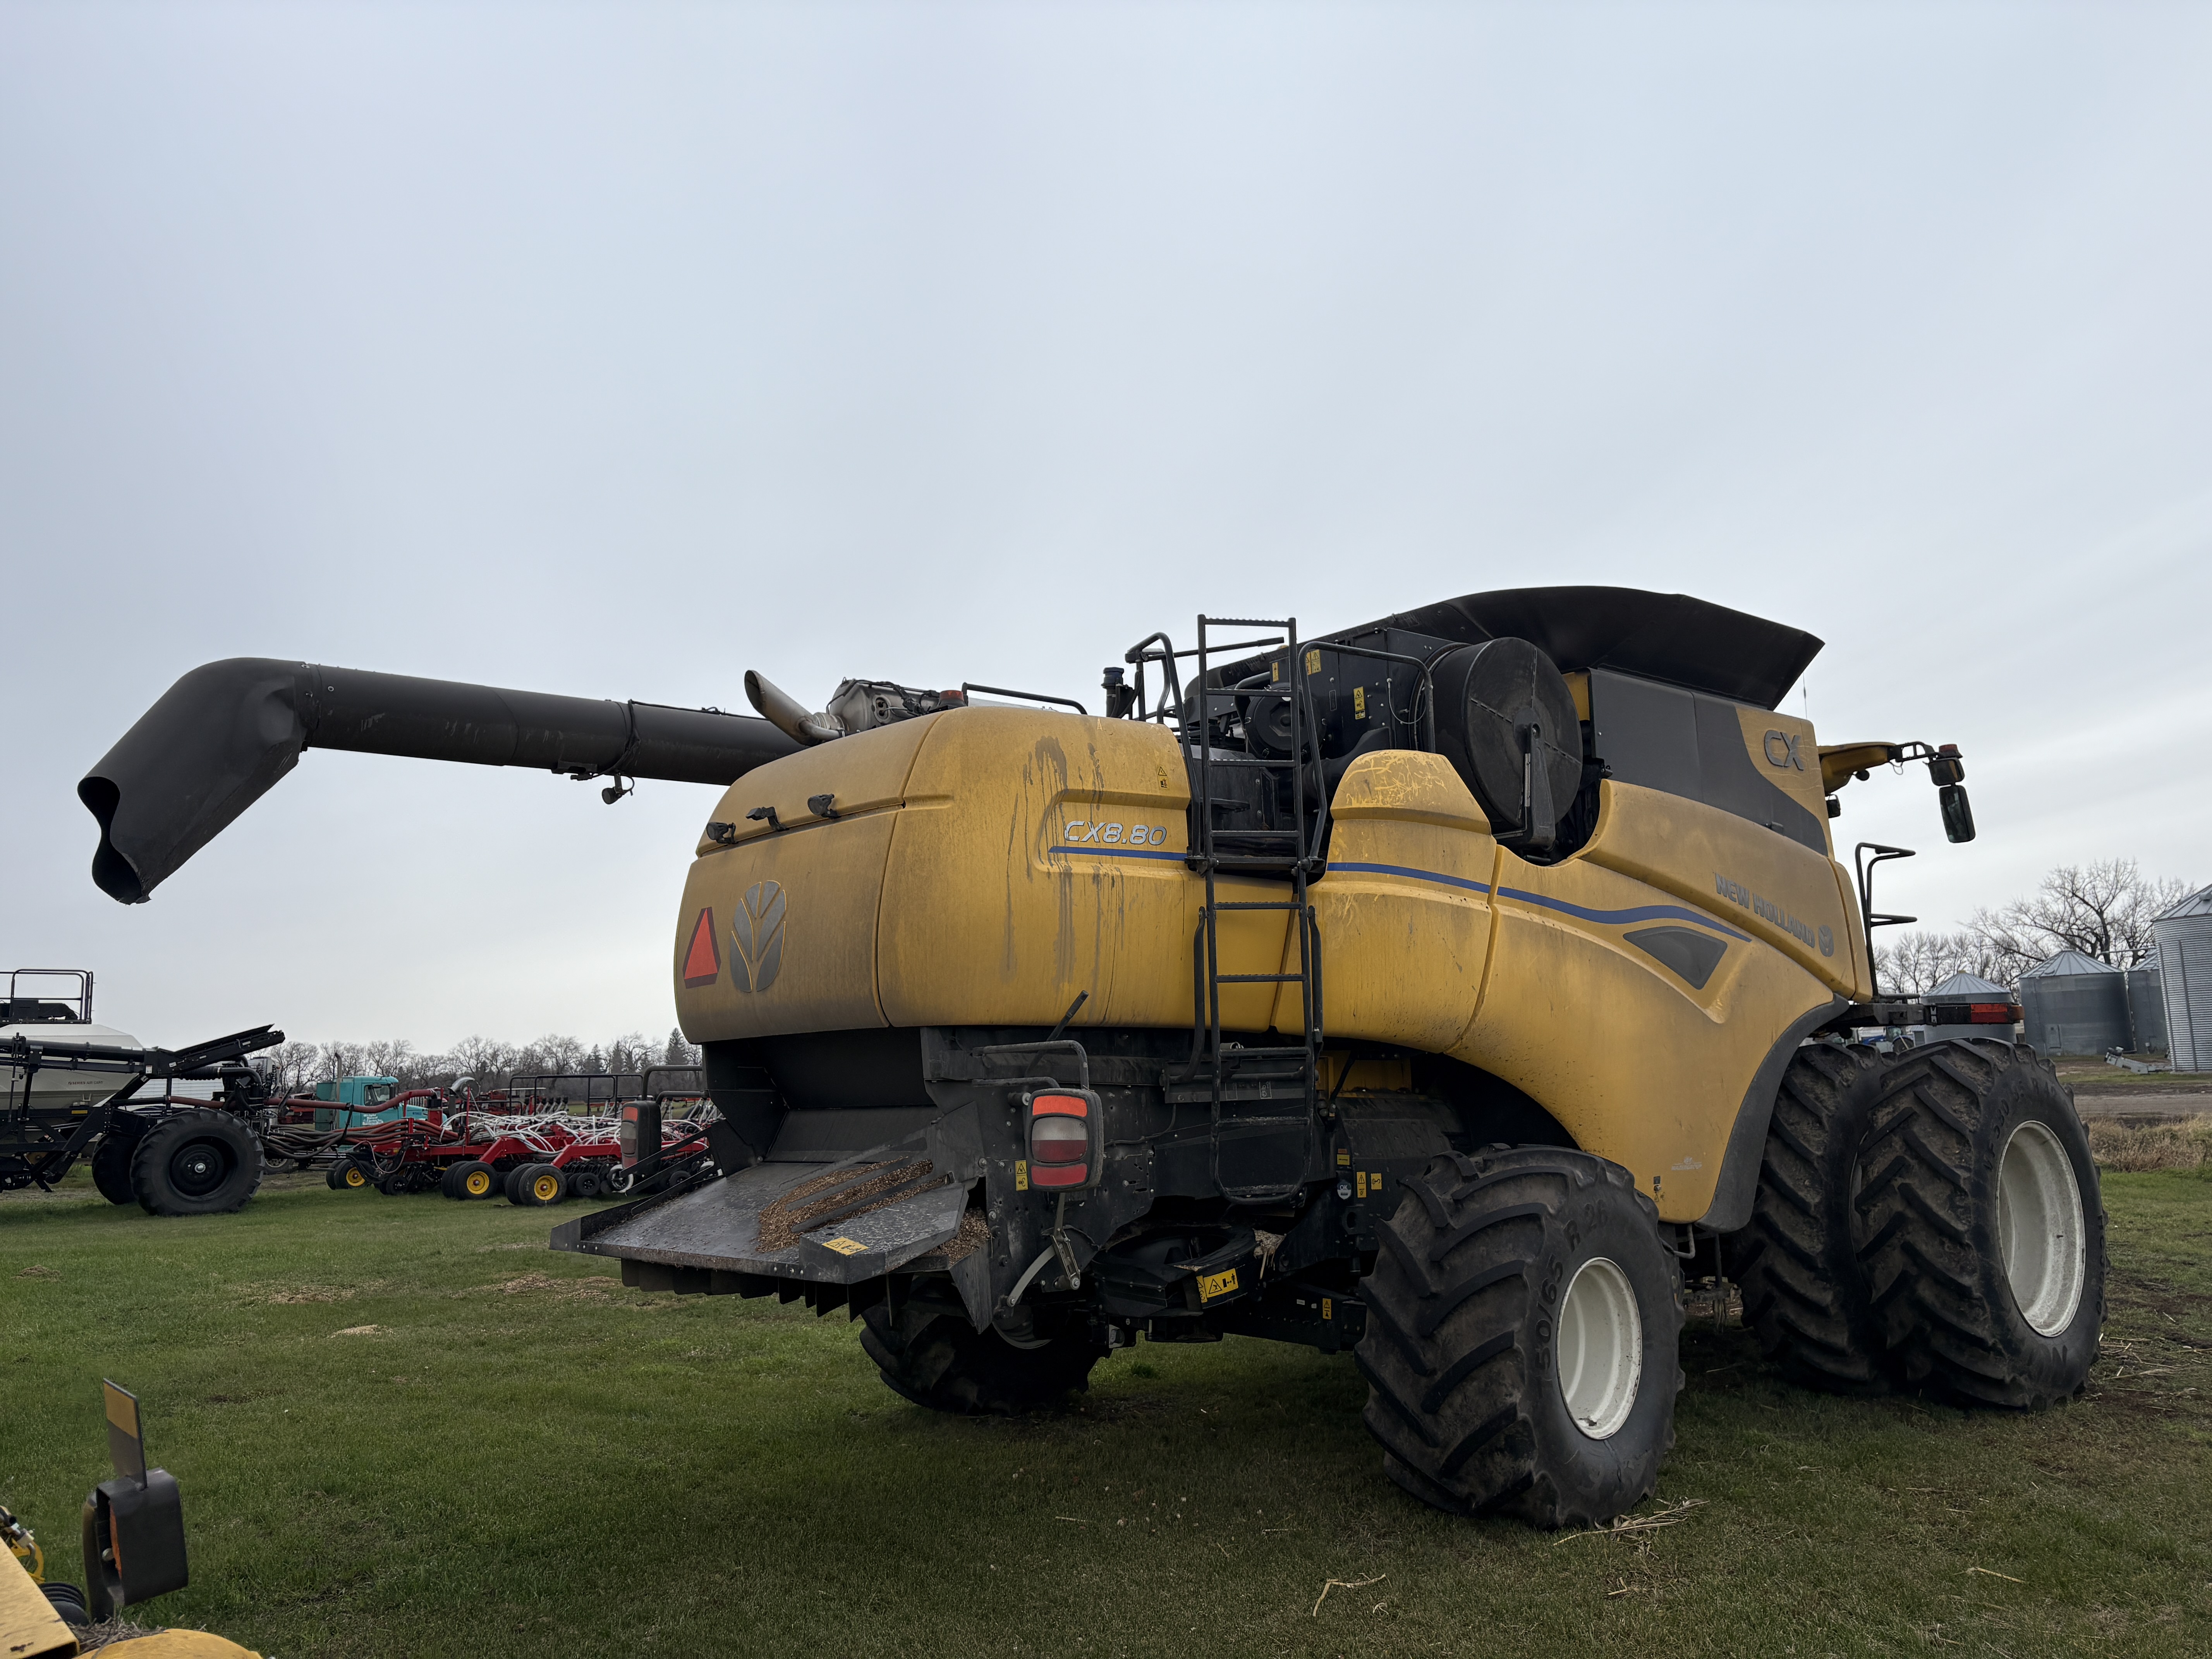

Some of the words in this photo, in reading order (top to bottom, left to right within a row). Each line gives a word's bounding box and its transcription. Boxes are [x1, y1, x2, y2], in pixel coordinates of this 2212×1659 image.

[1764, 729, 1804, 771] CX
[1064, 820, 1167, 845] CX8.80
[1715, 873, 1750, 910] NEW
[1753, 892, 1815, 948] HOLLAND
